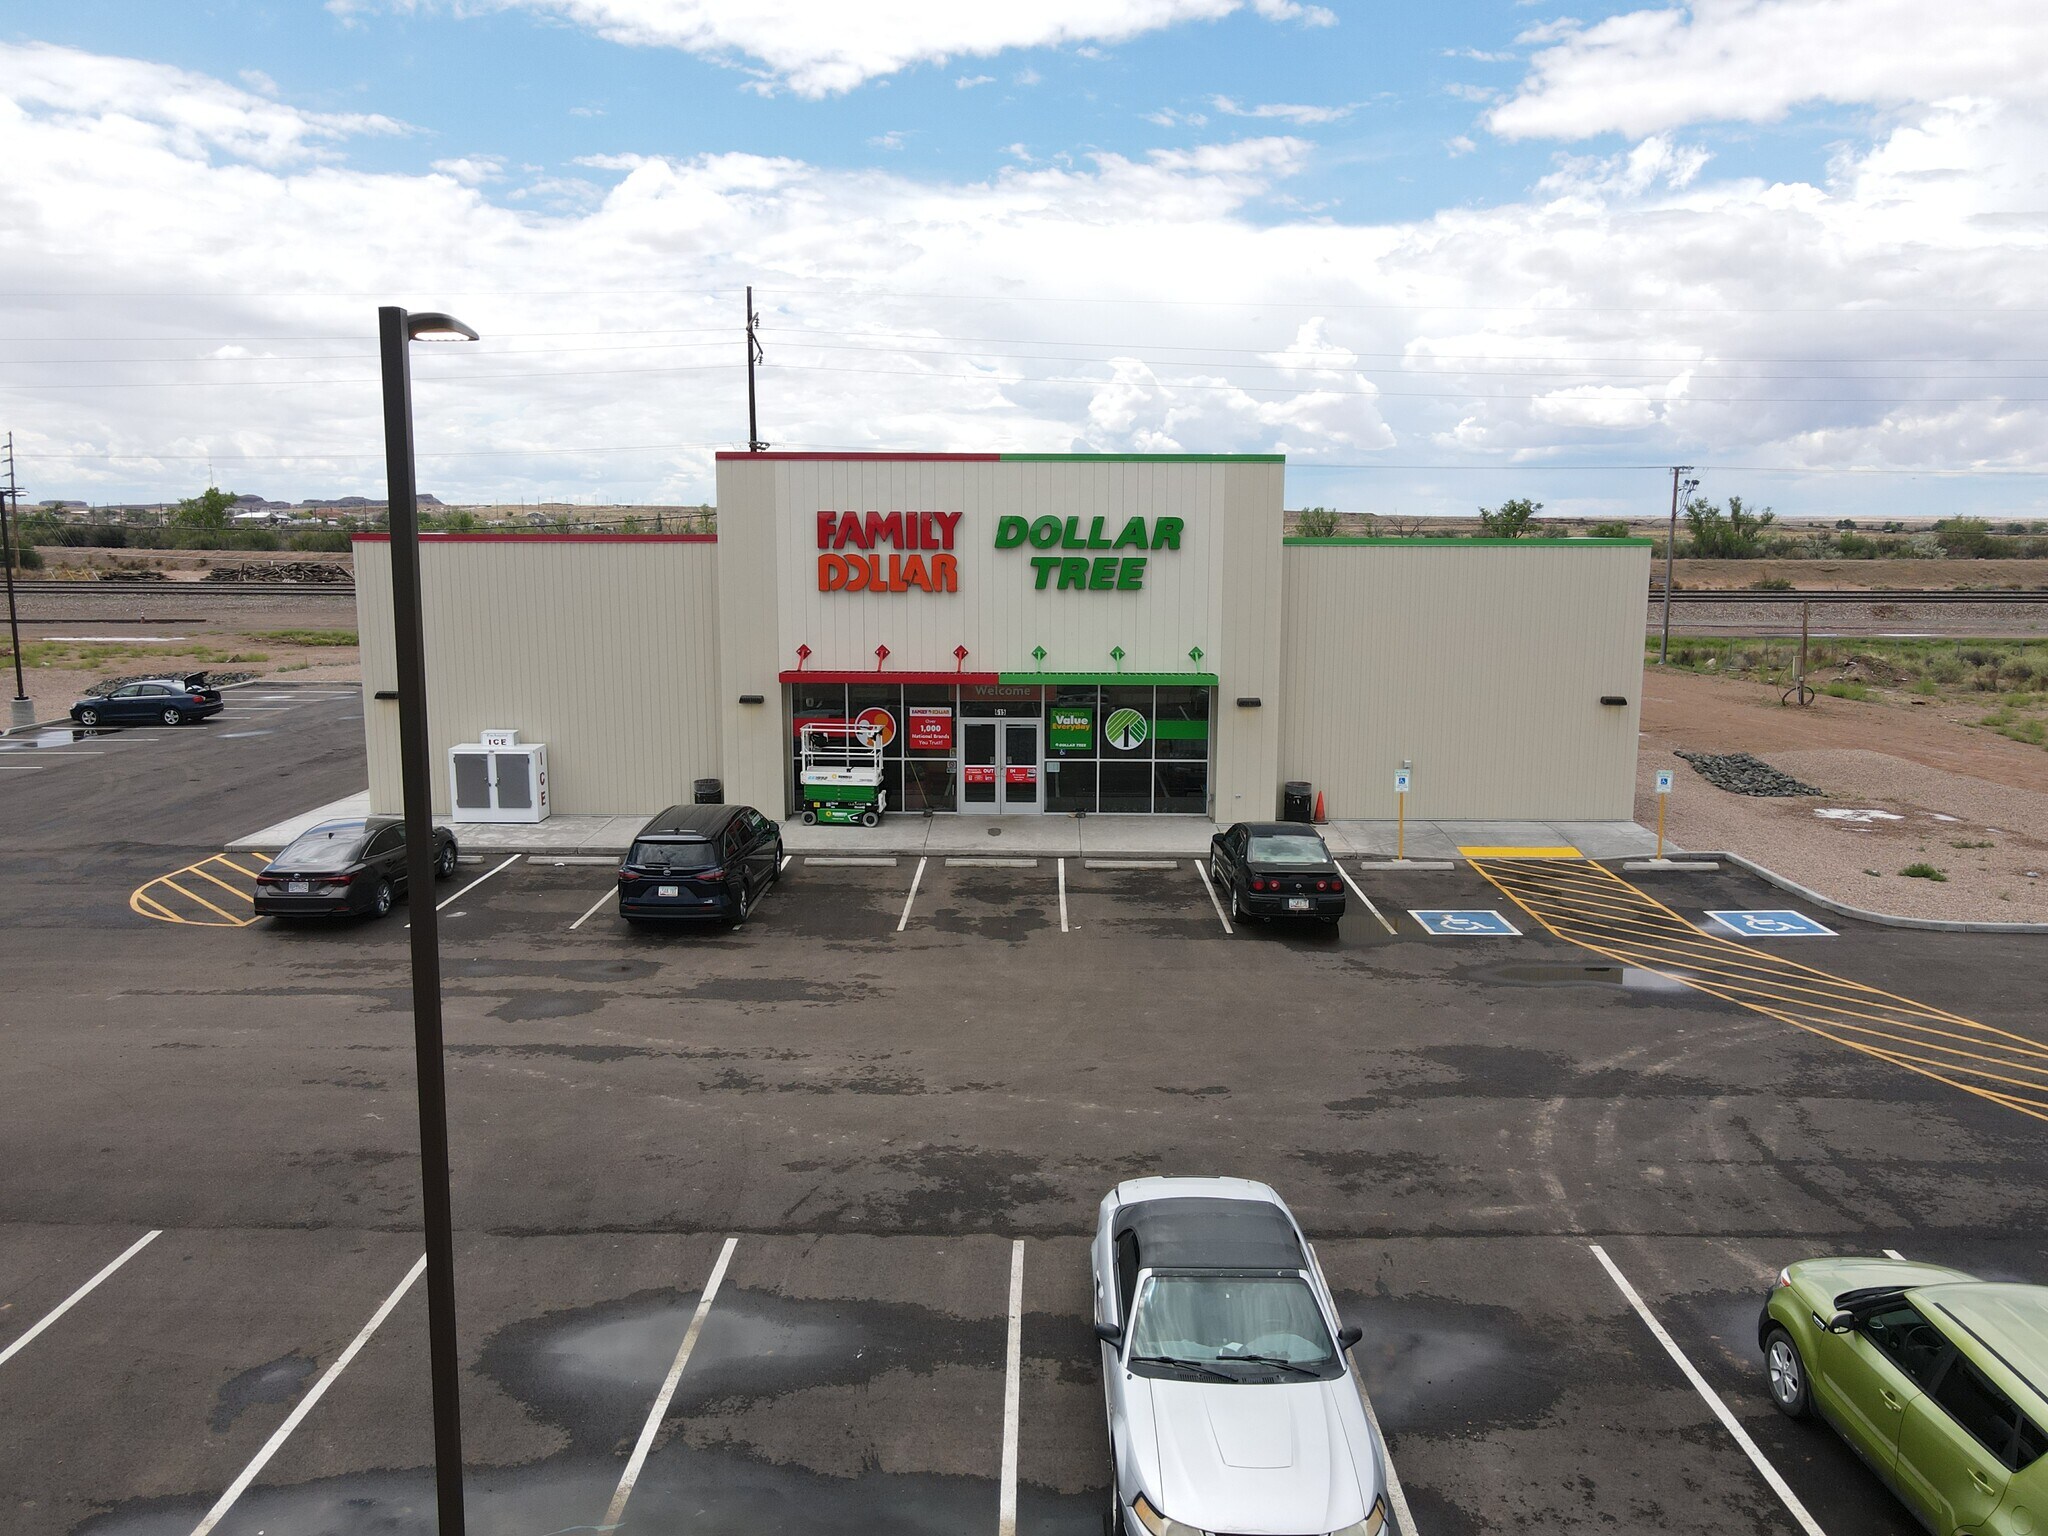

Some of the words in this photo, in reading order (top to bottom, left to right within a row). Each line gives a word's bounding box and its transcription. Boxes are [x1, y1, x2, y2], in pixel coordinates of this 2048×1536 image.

[817, 511, 963, 549] FAMILY
[994, 515, 1184, 549] DOLLAR
[817, 554, 958, 592] DOLLAR
[1030, 556, 1148, 590] TREE
[975, 685, 1031, 696] Welcome
[1056, 715, 1089, 724] Value
[920, 724, 941, 732] 1,000
[1052, 723, 1090, 731] Everyday
[488, 738, 507, 746] ICE
